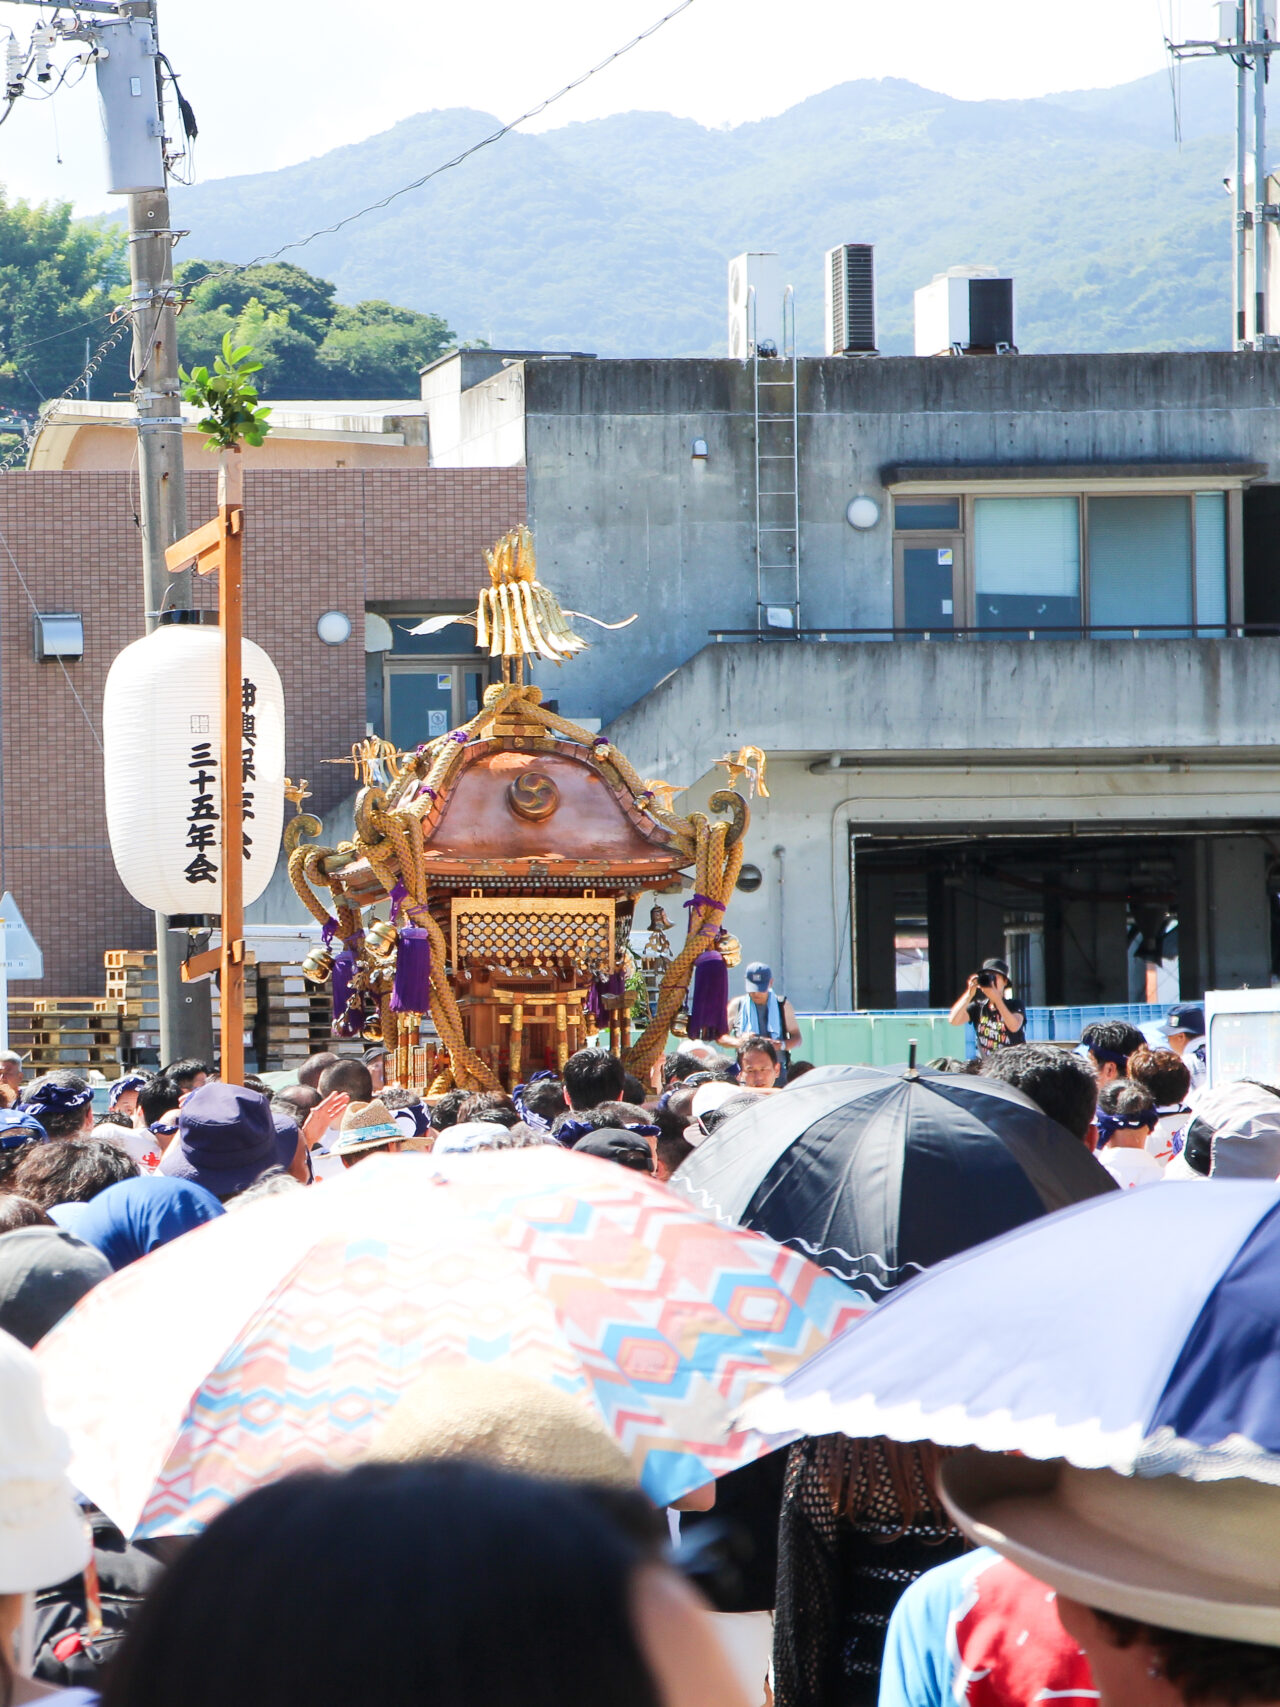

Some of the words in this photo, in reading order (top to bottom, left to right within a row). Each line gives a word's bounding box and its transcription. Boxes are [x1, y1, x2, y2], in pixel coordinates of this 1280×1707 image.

[183, 742, 221, 884] 三十五年会
